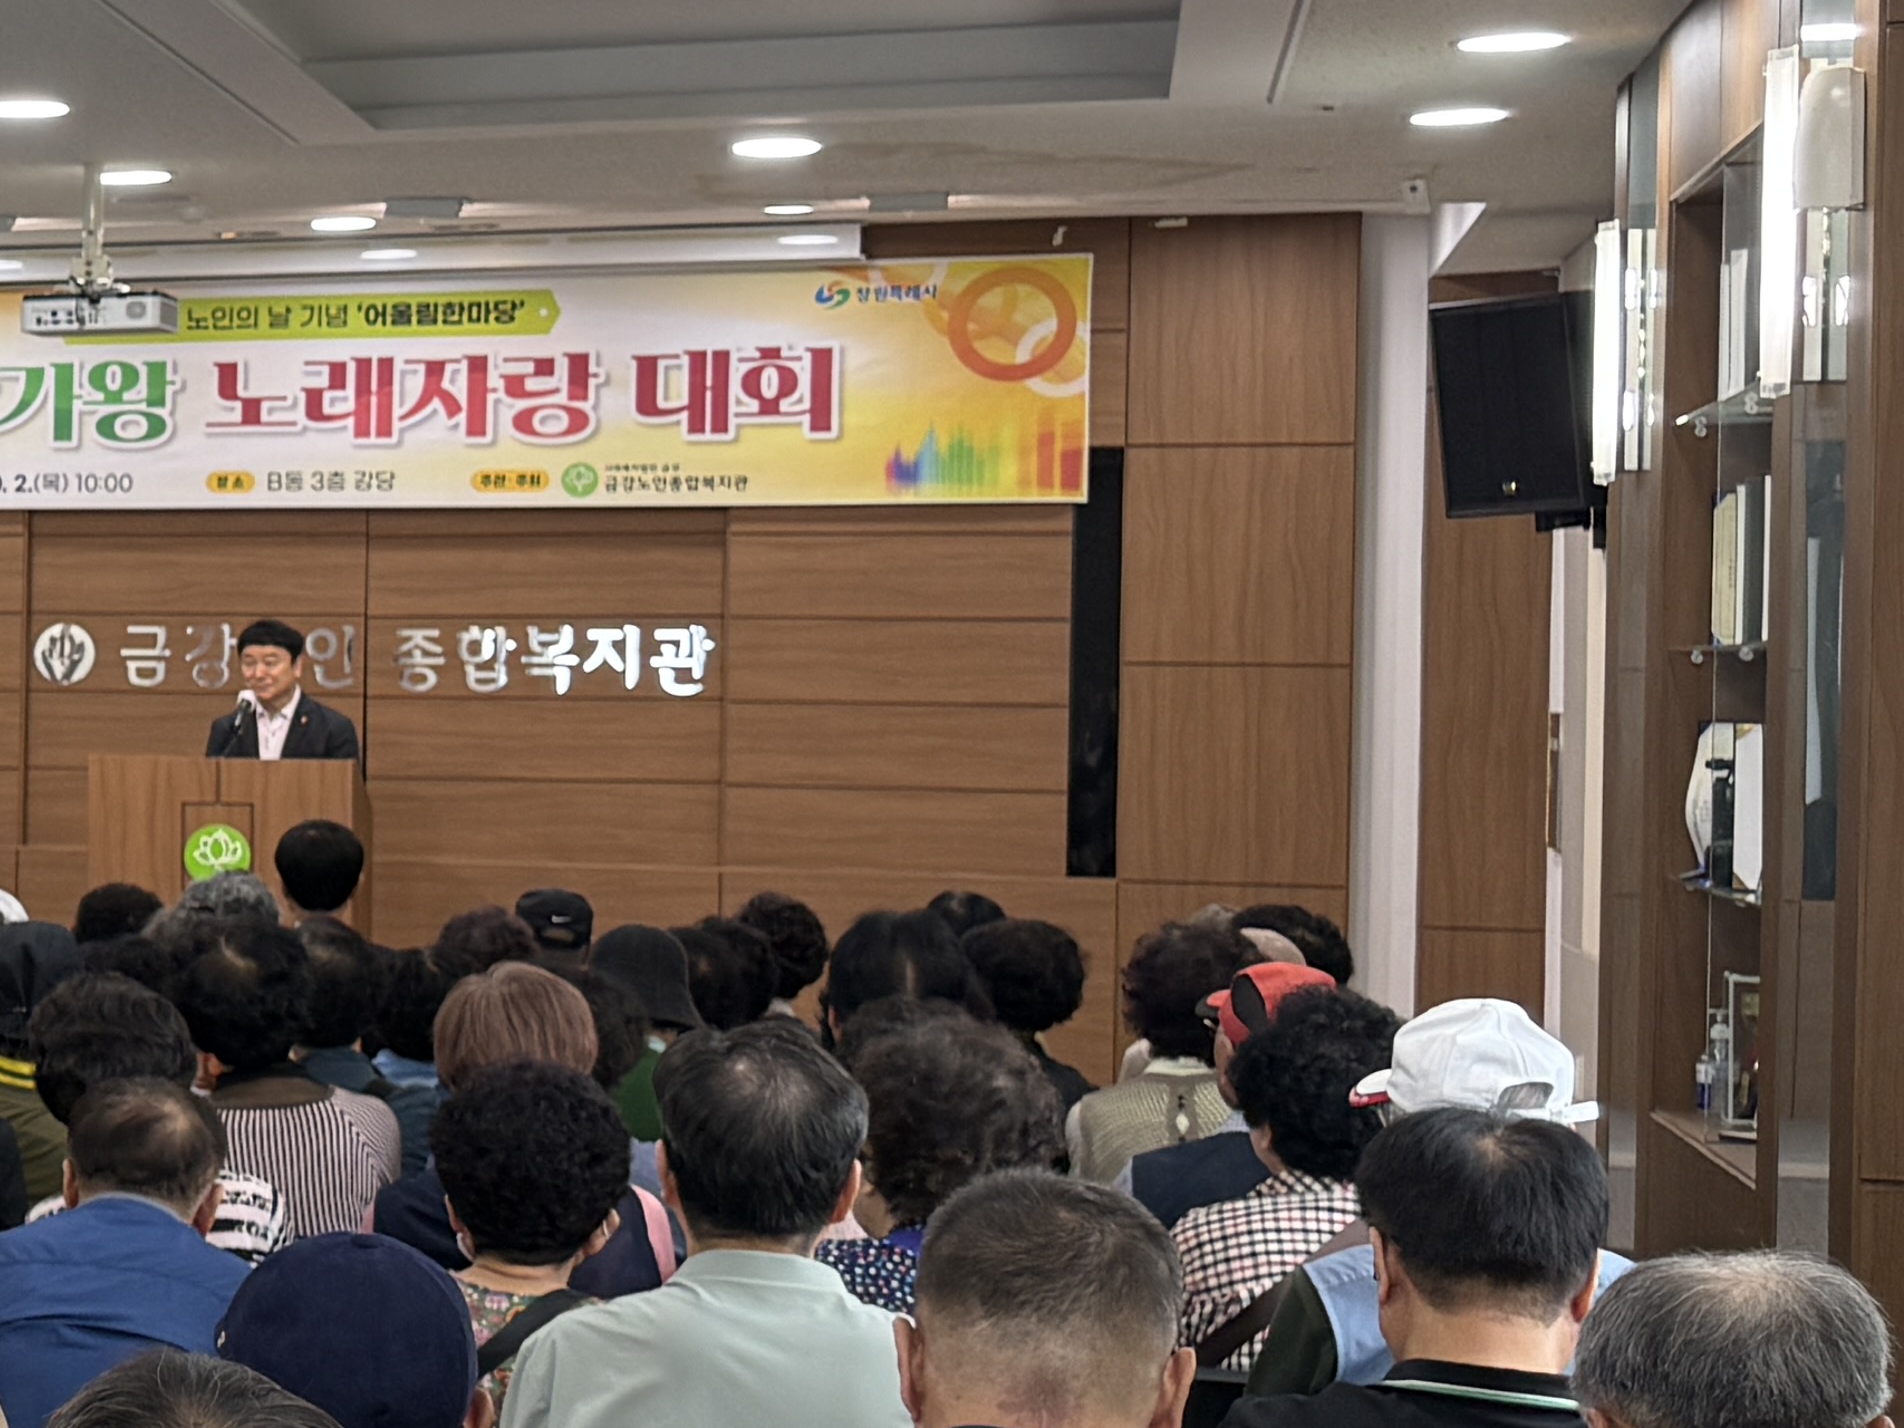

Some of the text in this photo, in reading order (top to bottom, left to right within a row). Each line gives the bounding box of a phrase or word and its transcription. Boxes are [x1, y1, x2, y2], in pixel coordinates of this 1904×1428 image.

[185, 305, 259, 332] 노인의
[268, 304, 293, 330] 날
[299, 303, 349, 330] 기념
[202, 348, 605, 444] 노래자랑
[629, 343, 840, 439] 대회
[75, 471, 134, 494] 10:00
[266, 470, 396, 493] B동 3층 강당
[118, 622, 716, 698] 금강인 종합복지관
